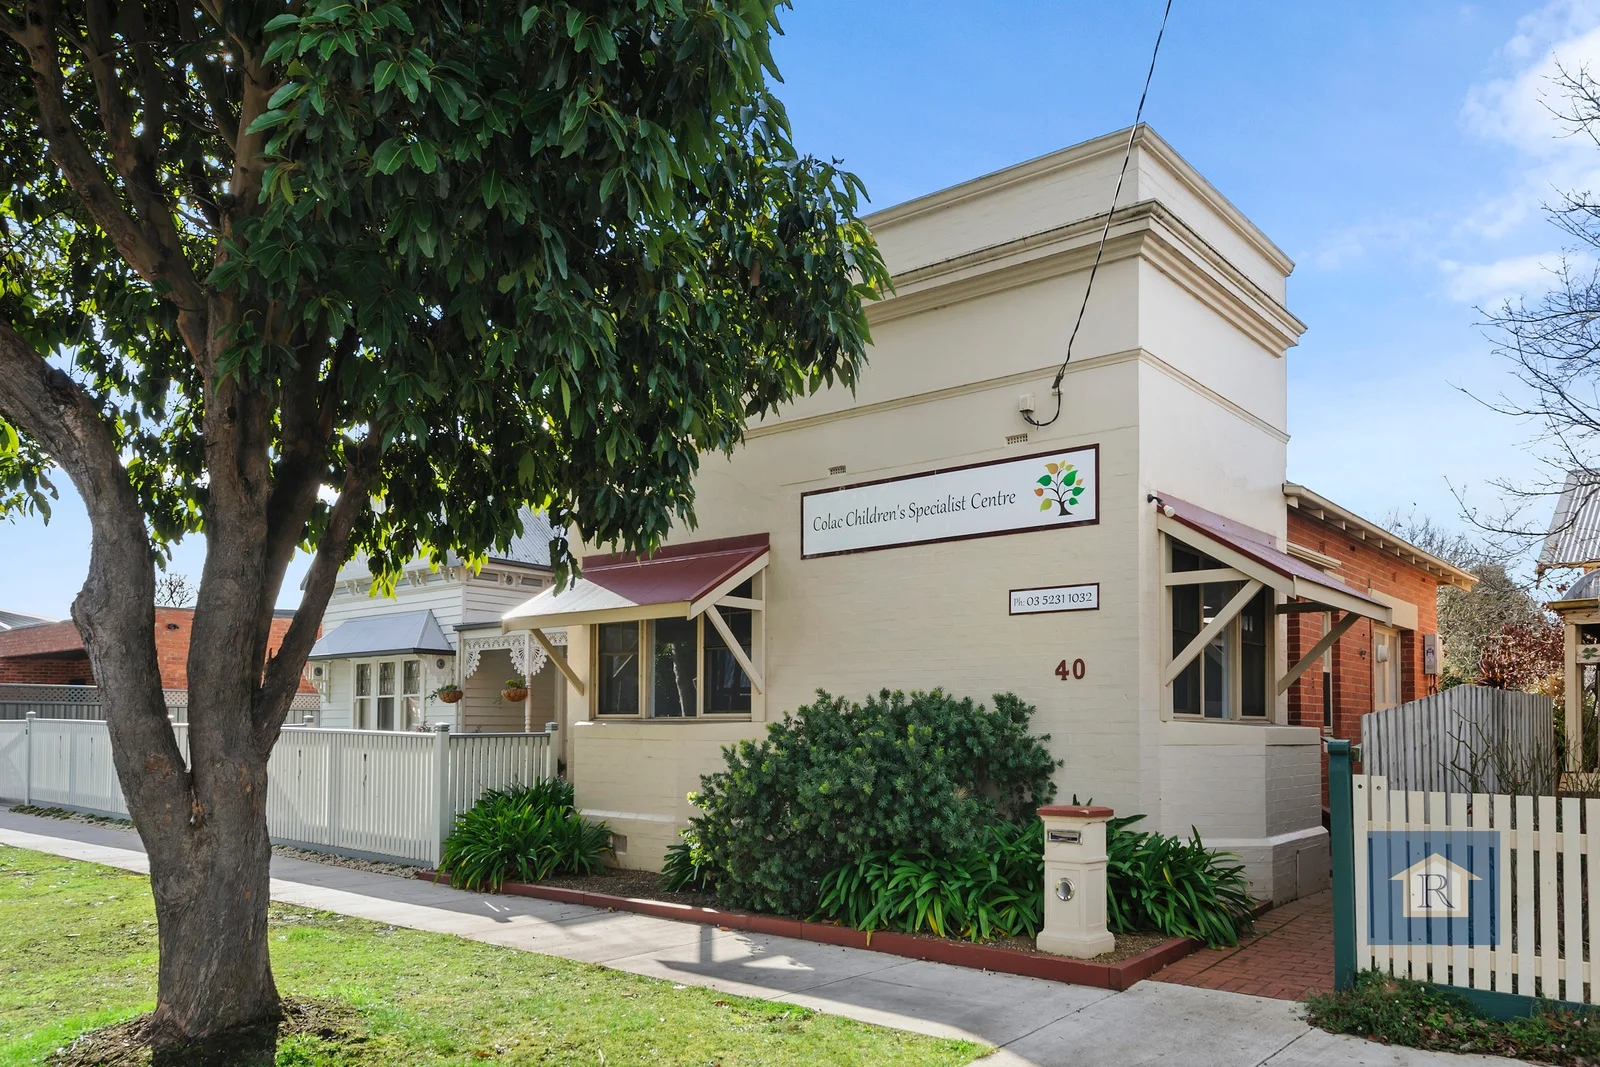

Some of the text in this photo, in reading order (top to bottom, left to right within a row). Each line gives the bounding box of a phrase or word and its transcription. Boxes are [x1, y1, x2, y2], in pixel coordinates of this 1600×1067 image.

[813, 490, 1016, 532] Colac Children's Specialist Centre
[1014, 592, 1093, 607] Ph: 03 5231 1032
[1055, 658, 1086, 681] 40
